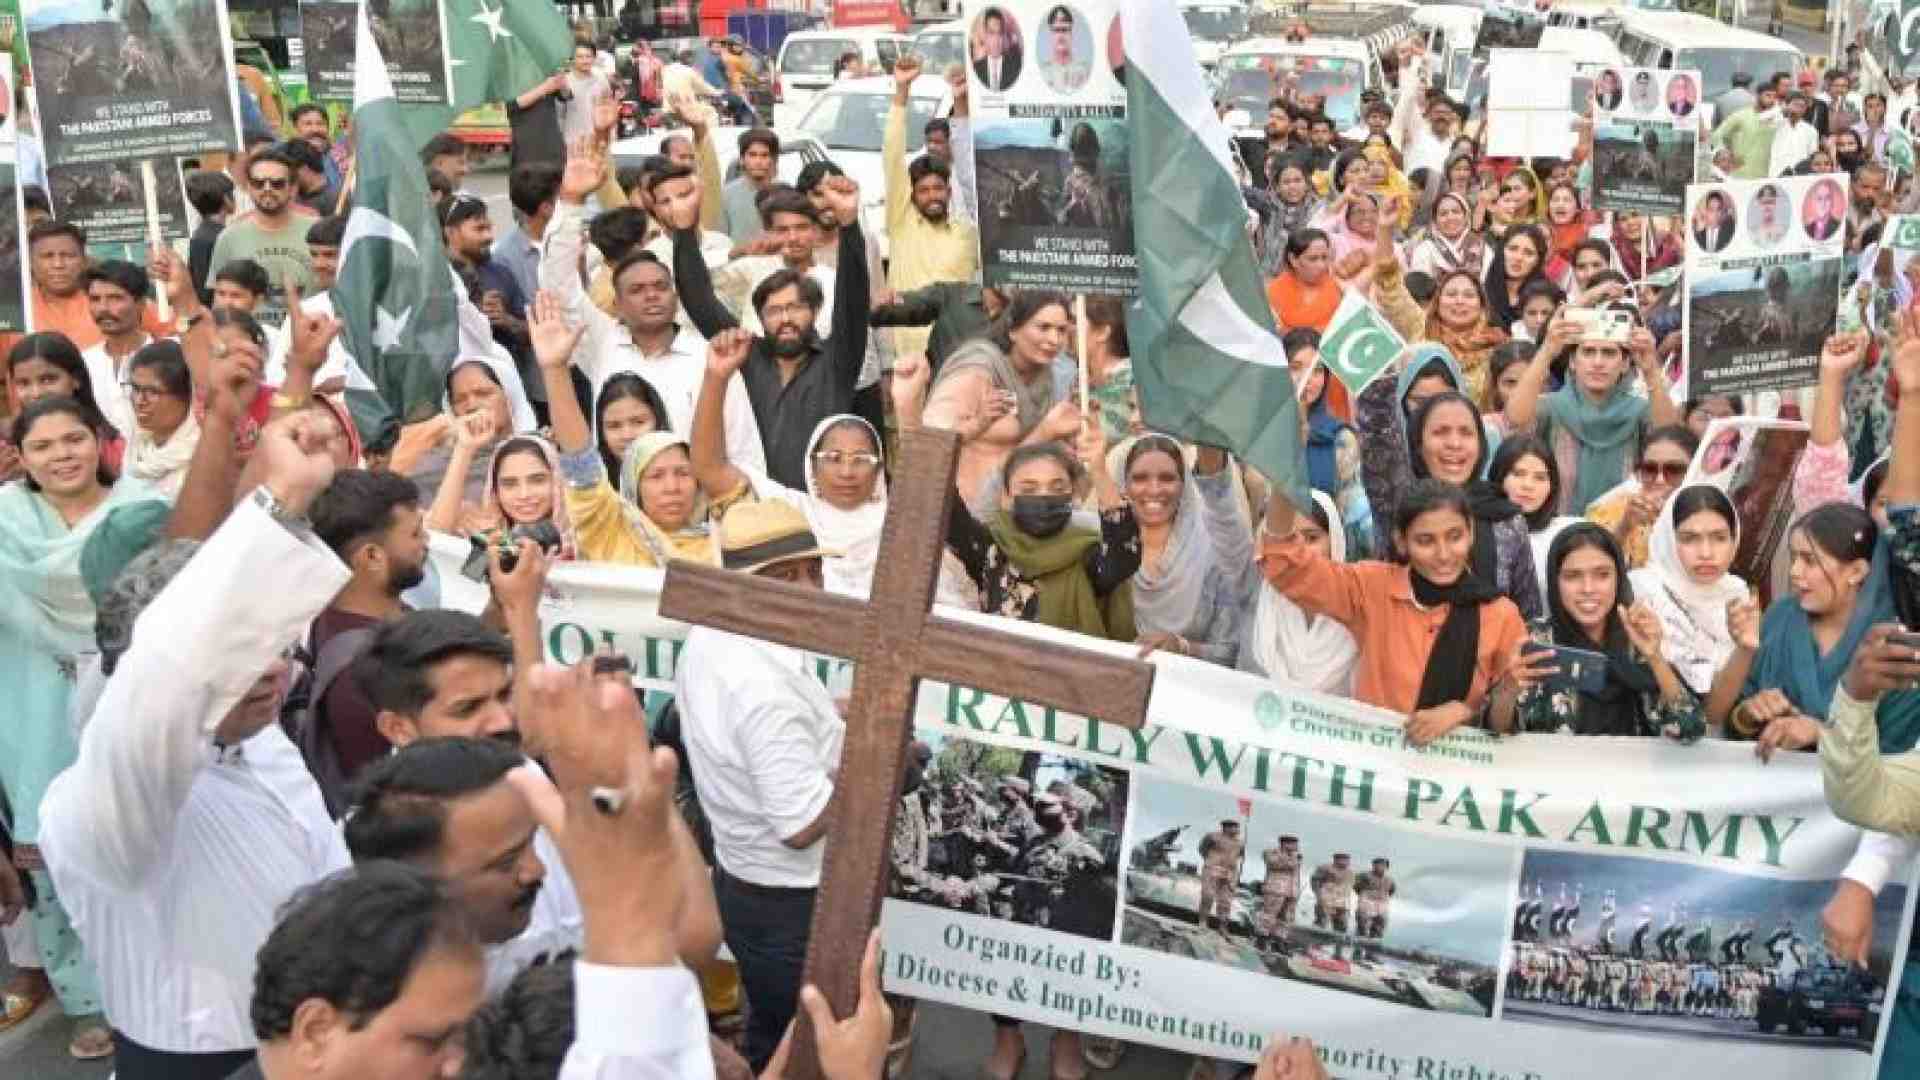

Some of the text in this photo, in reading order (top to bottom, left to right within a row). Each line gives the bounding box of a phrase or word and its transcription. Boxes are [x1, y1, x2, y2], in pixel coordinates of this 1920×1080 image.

[60, 123, 80, 136] THE
[173, 108, 212, 125] FORCES
[999, 249, 1018, 263] THE
[1073, 253, 1109, 268] ARMED
[945, 684, 1804, 867] RALLY WITH PAK ARMY
[942, 923, 1086, 977] Organzied
[1096, 953, 1141, 992] By:
[897, 952, 999, 997] Diocese
[1006, 978, 1029, 1003] &
[1039, 983, 1264, 1052] Implementation
[1292, 1037, 1401, 1076] nority
